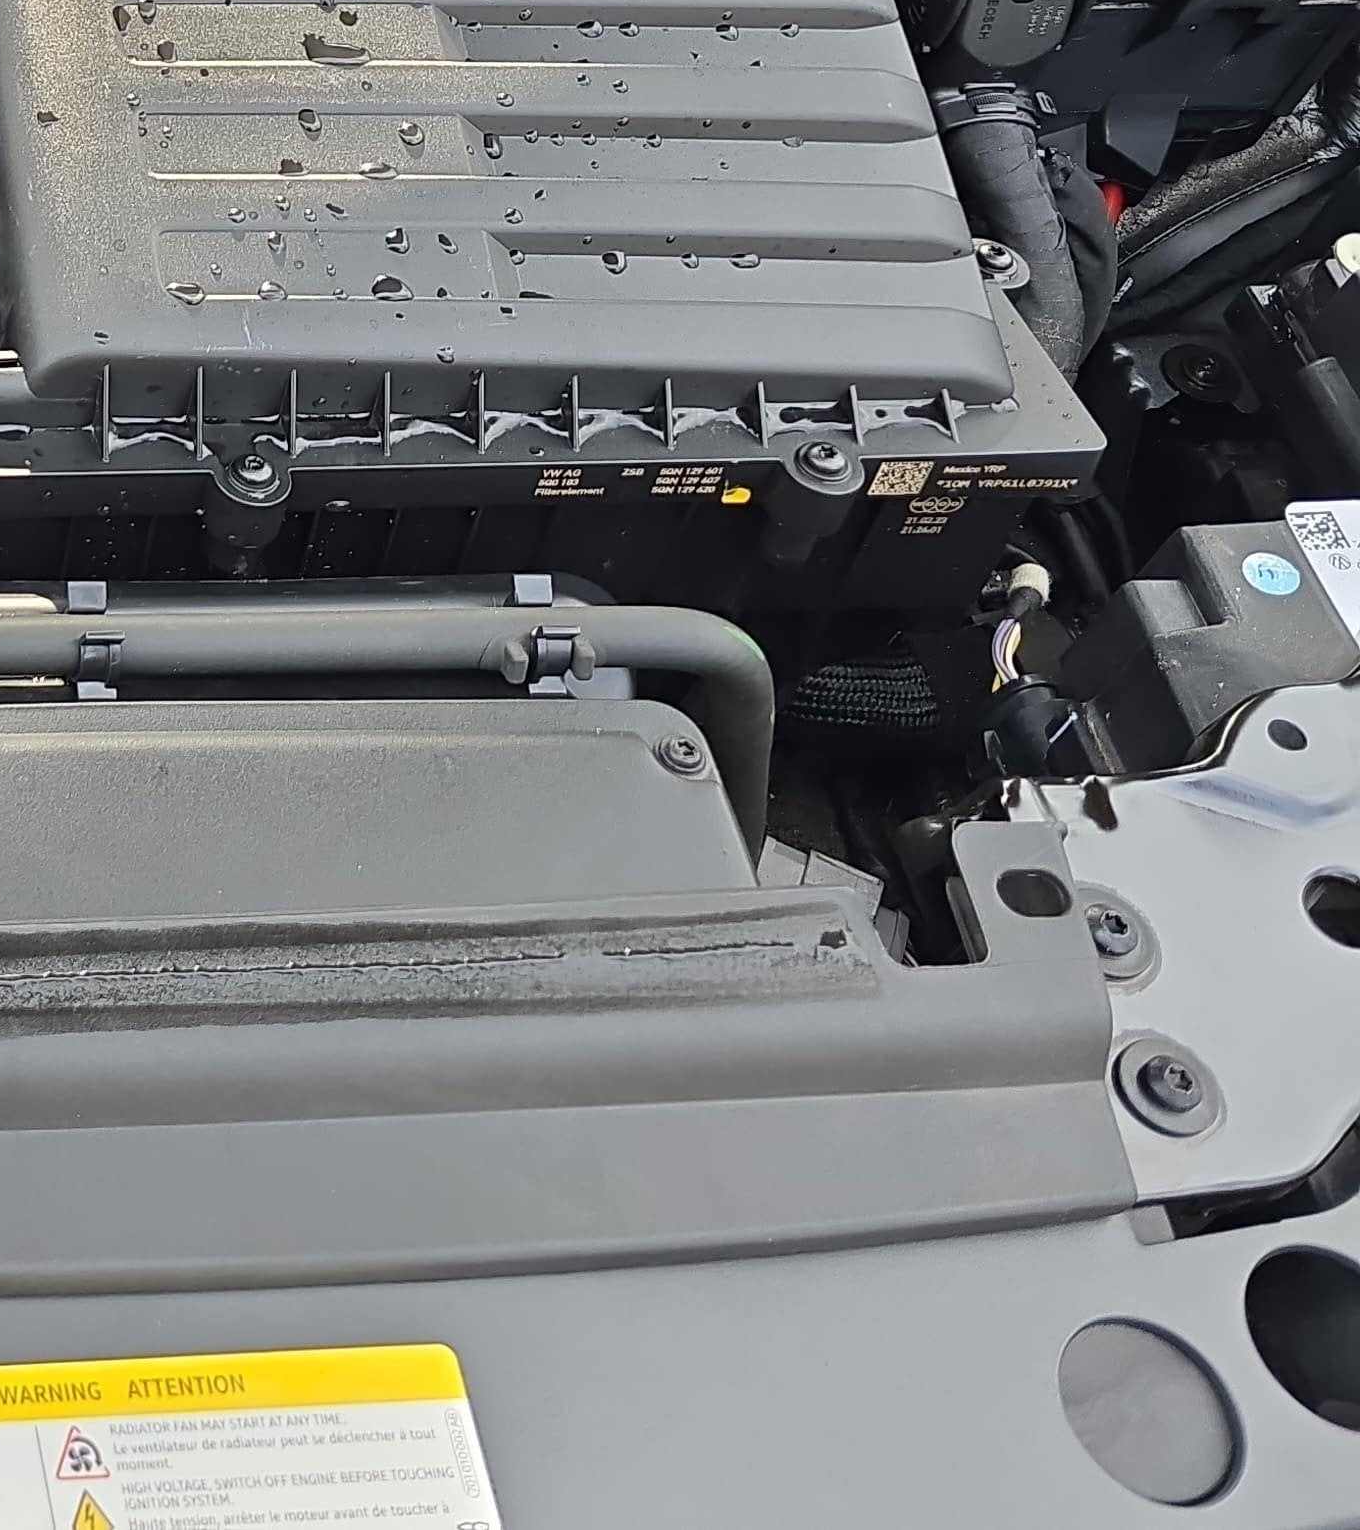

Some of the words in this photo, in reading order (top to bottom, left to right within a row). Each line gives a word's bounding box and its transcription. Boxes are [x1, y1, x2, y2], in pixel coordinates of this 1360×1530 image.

[543, 469, 563, 477] VW
[983, 464, 1007, 472] YRP
[681, 476, 699, 484] 129
[128, 1374, 246, 1399] ATTENTION
[109, 1422, 170, 1435] RADIATOR
[174, 1420, 197, 1432] FAN
[200, 1418, 224, 1429] MAY
[229, 1416, 264, 1428] START
[269, 1415, 282, 1426] AT
[287, 1414, 309, 1425] ANY
[113, 1442, 128, 1454] Le
[132, 1438, 197, 1454] ventilateur
[202, 1438, 216, 1448] de
[221, 1436, 275, 1448] radiateur
[281, 1434, 307, 1447] peut
[312, 1435, 324, 1444] se
[329, 1430, 394, 1443] déclencher
[410, 1428, 435, 1439] tout
[122, 1481, 151, 1494] HIGH
[214, 1476, 261, 1490] SWITCH
[264, 1474, 287, 1486] OFF
[291, 1473, 337, 1485] ENGINE
[340, 1470, 386, 1483] BEFORE
[391, 1466, 454, 1480] TOUCHING
[124, 1495, 179, 1509] IGNITION
[128, 1518, 164, 1530] Haute
[169, 1516, 220, 1528] tension,
[224, 1511, 265, 1524] arrêter
[269, 1511, 280, 1521] le
[284, 1510, 328, 1521] moteur
[334, 1508, 368, 1519] avant
[372, 1505, 384, 1517] de
[390, 1503, 439, 1516] toucher
